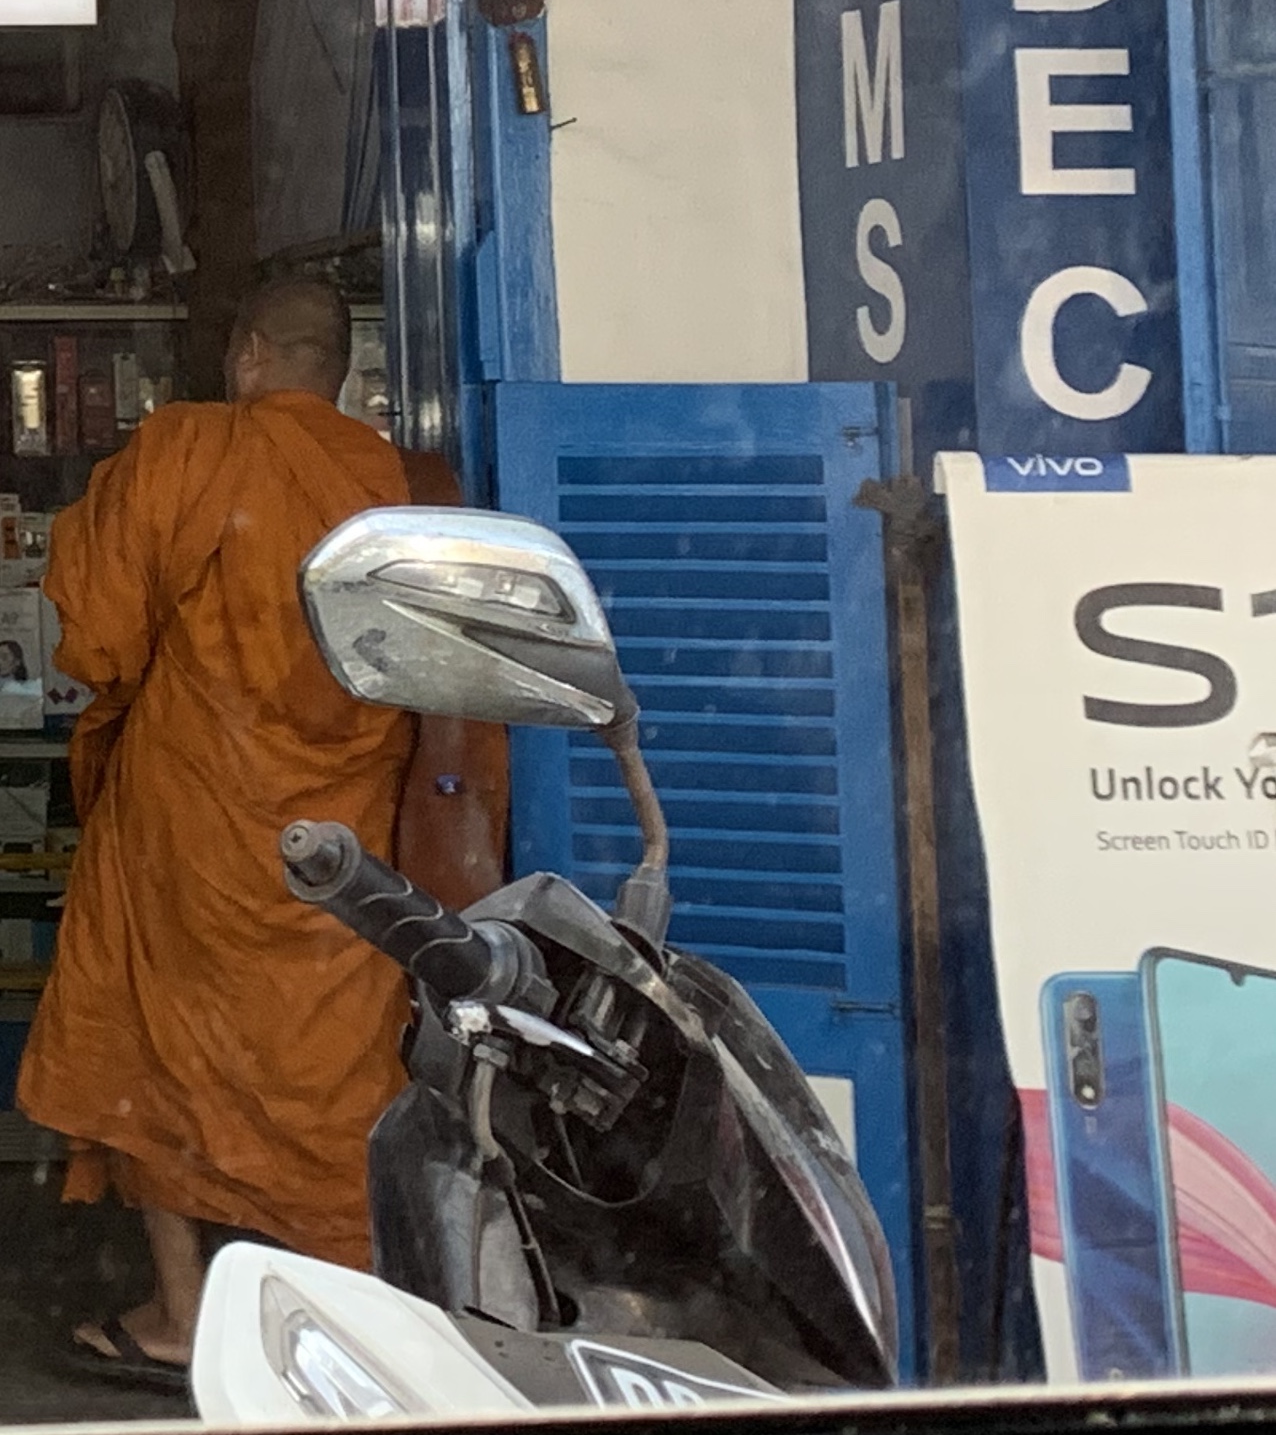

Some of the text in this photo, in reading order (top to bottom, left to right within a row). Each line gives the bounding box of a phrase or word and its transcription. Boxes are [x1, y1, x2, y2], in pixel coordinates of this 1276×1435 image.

[1089, 766, 1225, 801] Unlock
[1097, 830, 1270, 851] Screen Touch ID
